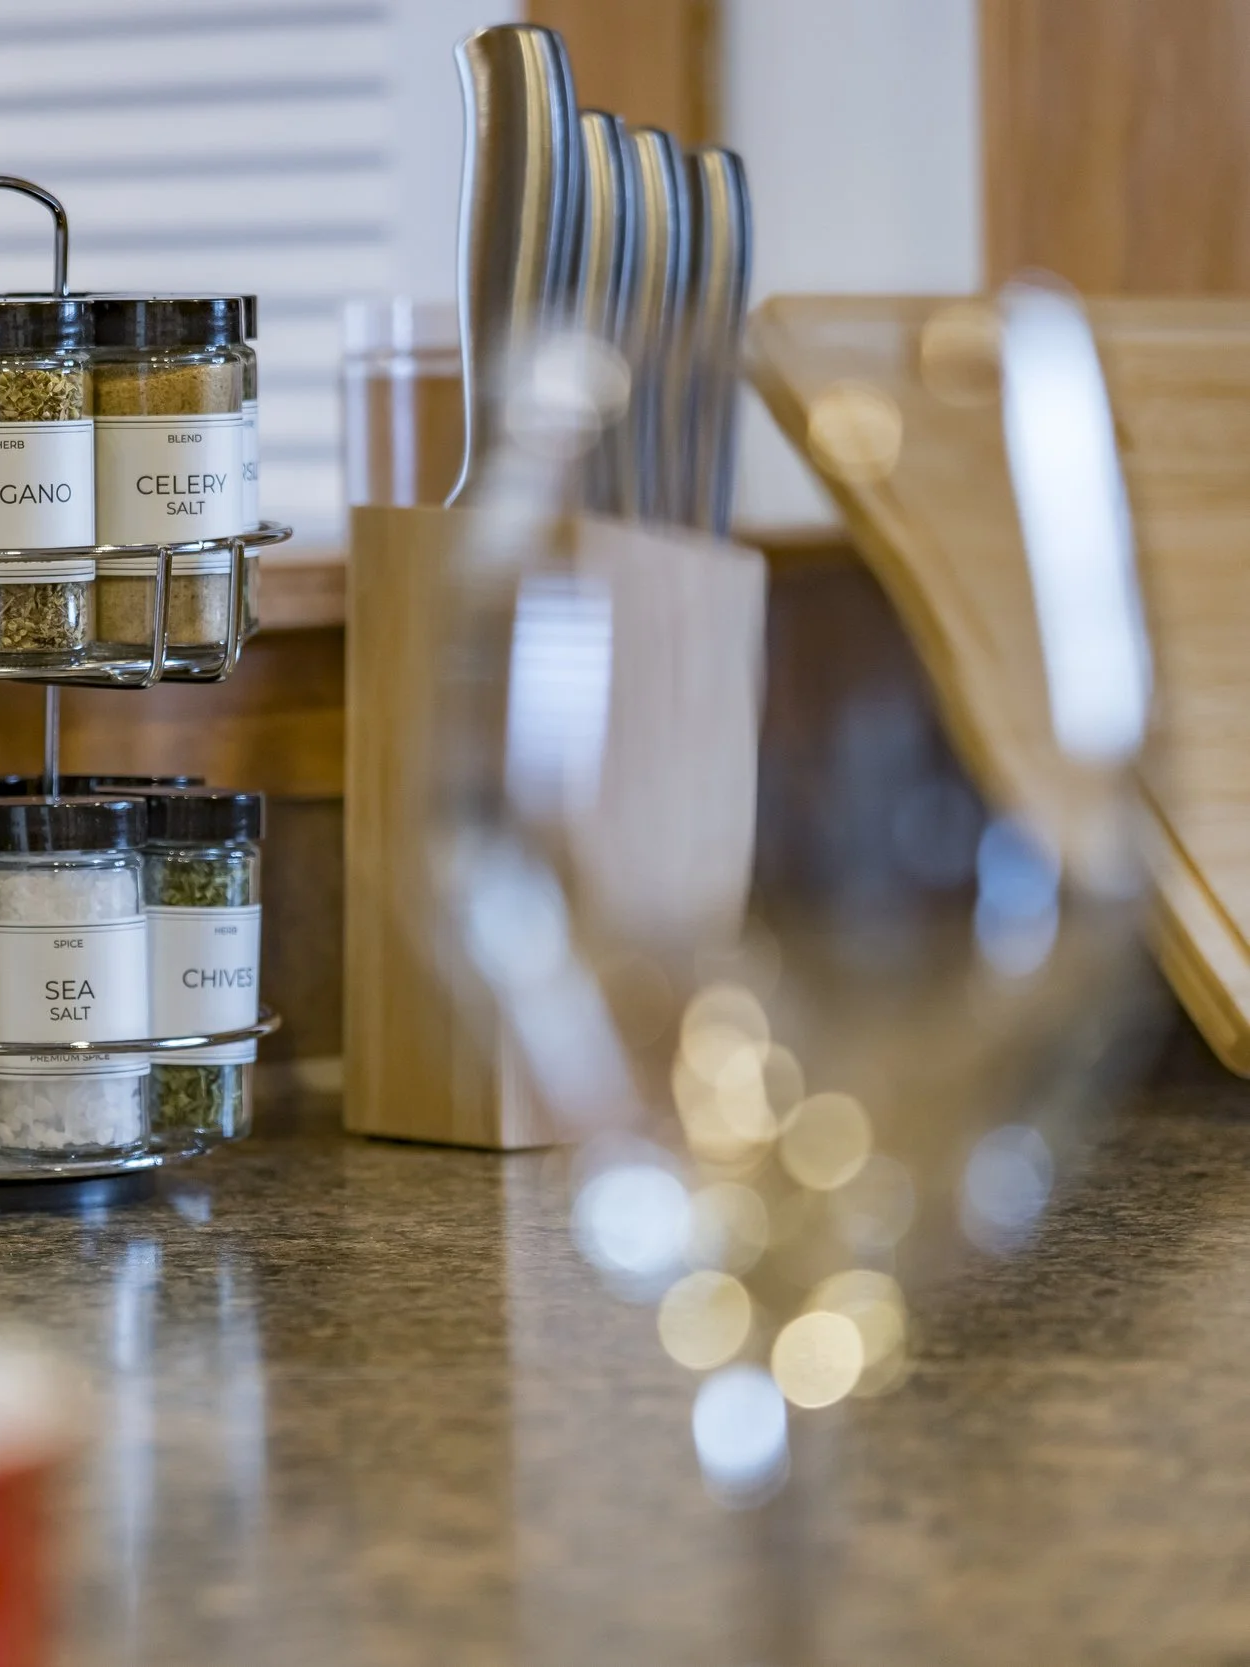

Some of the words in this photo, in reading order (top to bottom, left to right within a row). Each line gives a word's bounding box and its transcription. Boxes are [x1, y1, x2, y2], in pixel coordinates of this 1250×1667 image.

[167, 434, 202, 444] BLEND
[136, 473, 227, 496] CELERY
[166, 501, 205, 516] SALT
[53, 939, 84, 950] SPICE
[182, 967, 254, 990] CHIVES
[45, 980, 95, 1001] SEA
[50, 1006, 91, 1021] SALT
